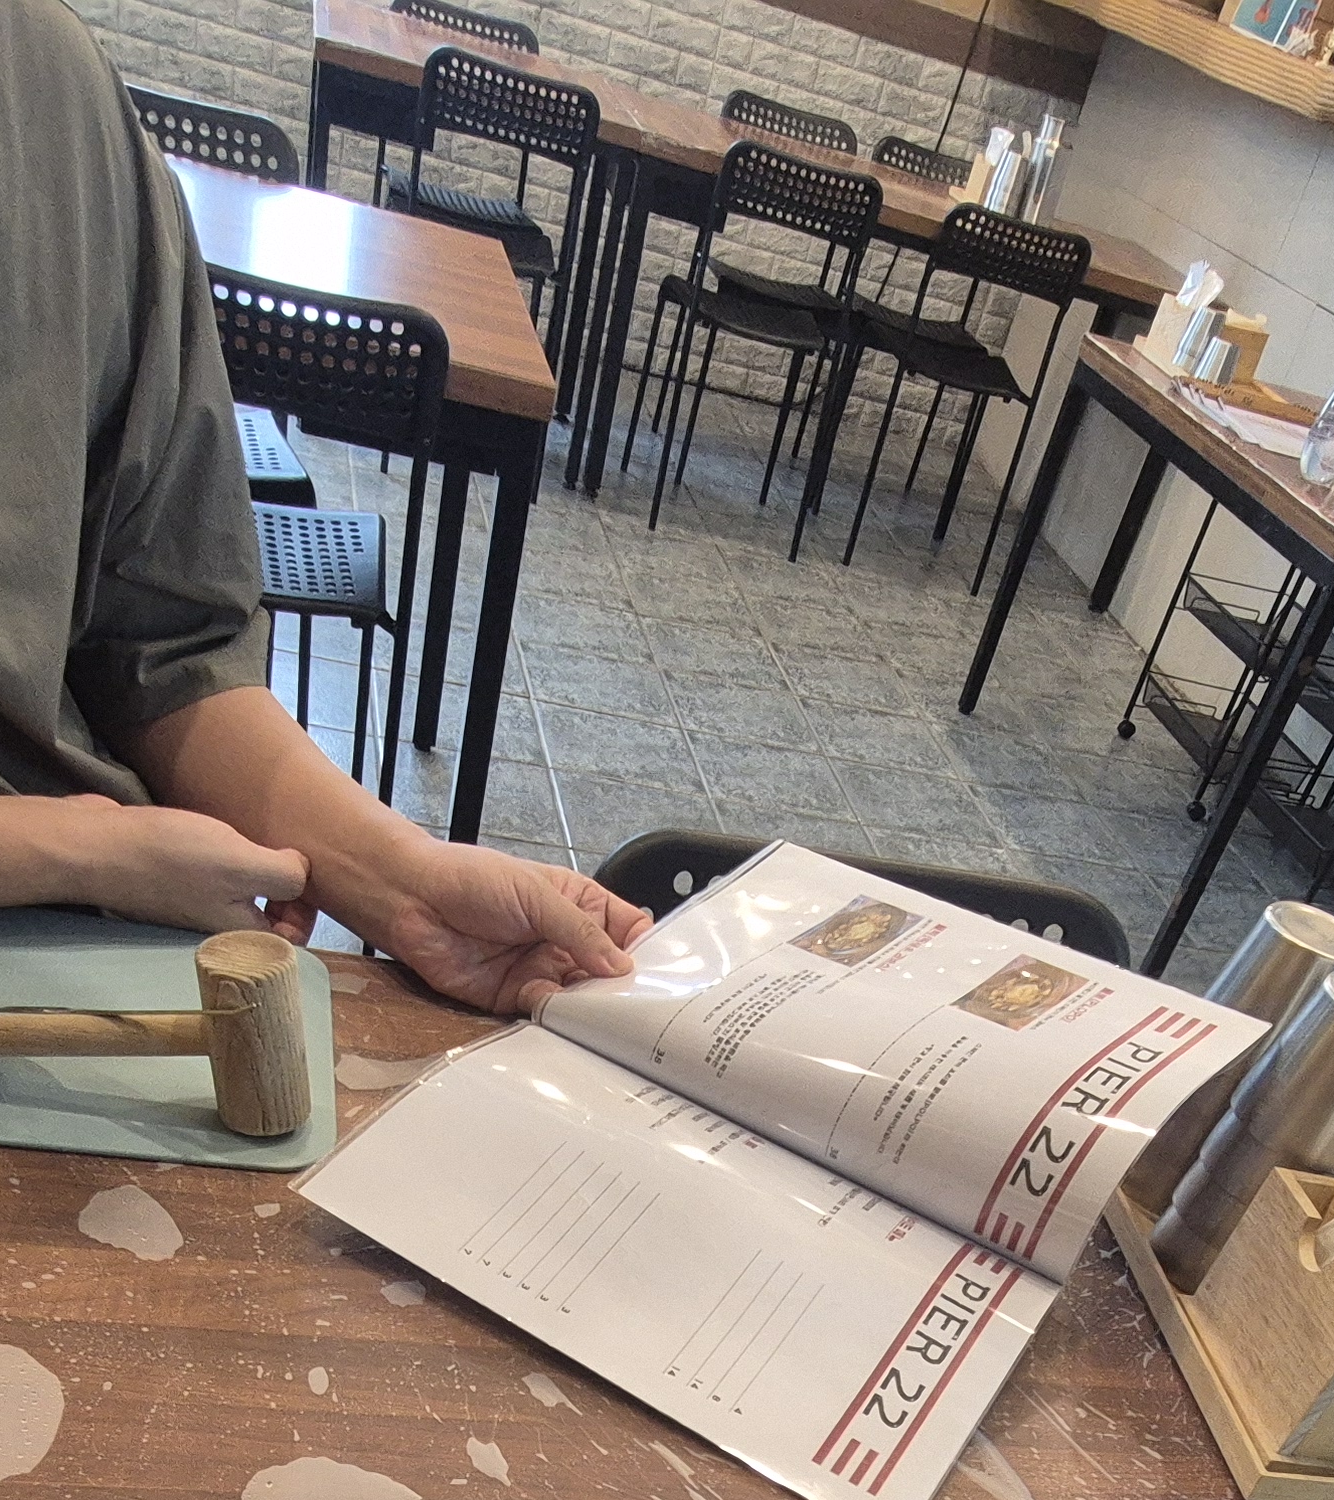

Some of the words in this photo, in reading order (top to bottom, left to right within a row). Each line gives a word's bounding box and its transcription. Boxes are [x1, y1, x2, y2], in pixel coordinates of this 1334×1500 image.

[1060, 1041, 1165, 1118] PIER
[1008, 1125, 1076, 1197] 22
[905, 1272, 991, 1365] PIER
[862, 1366, 927, 1429] 22
